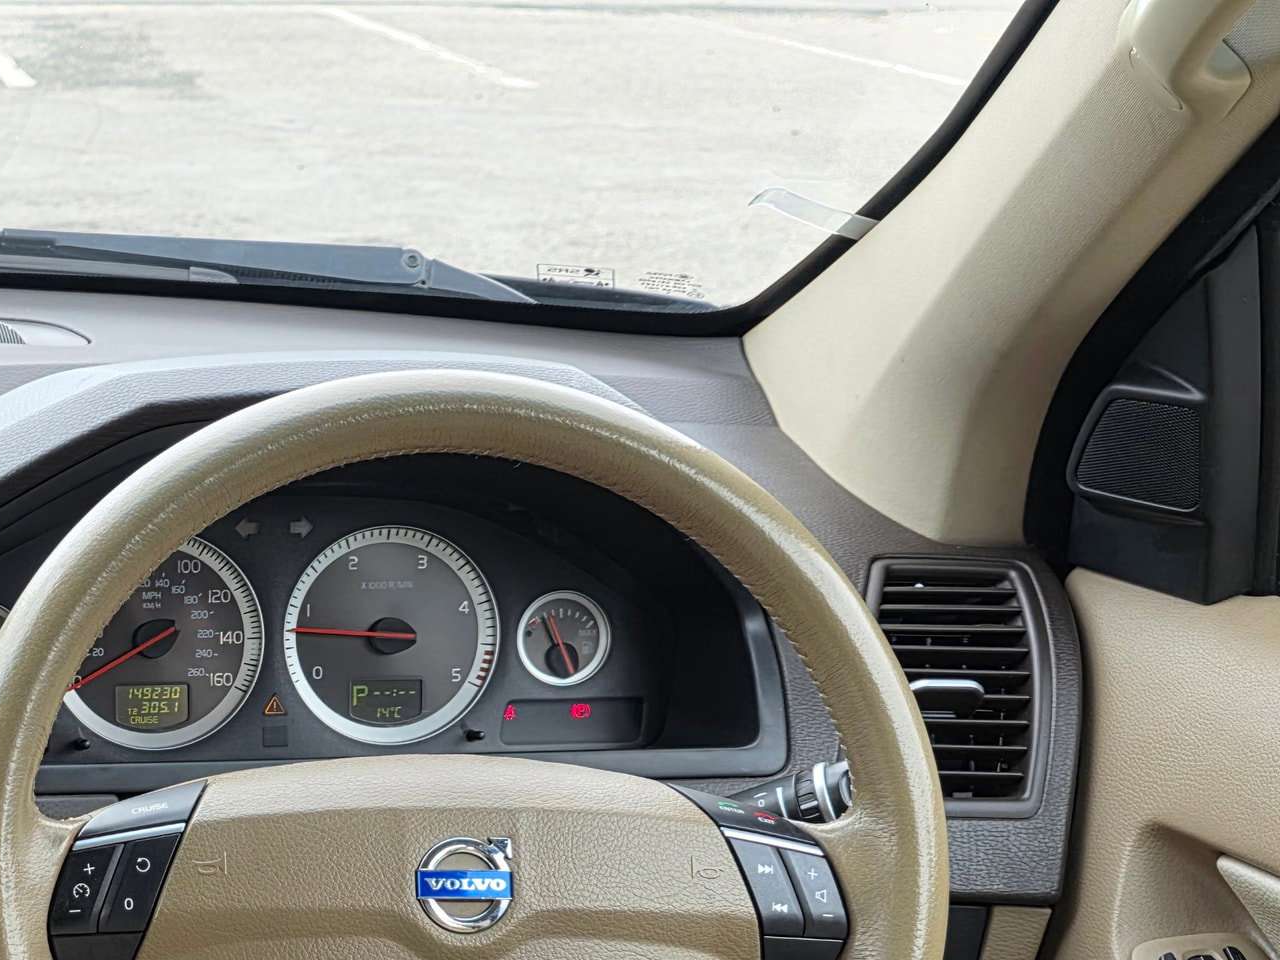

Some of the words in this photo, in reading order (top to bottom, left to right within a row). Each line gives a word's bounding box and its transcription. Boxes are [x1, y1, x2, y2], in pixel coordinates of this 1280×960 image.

[177, 560, 201, 574] 100
[348, 556, 358, 570] 2
[418, 555, 428, 569] 3
[142, 591, 161, 600] MPH
[184, 595, 198, 605] 180
[208, 589, 231, 603] 120
[306, 603, 311, 617] 1
[458, 600, 470, 614] 4
[191, 610, 209, 619] 200
[197, 629, 214, 638] 220
[220, 631, 243, 645] 140
[92, 647, 104, 657] 20
[195, 649, 213, 658] 240
[188, 668, 205, 677] 260
[210, 672, 233, 686] 160
[312, 666, 323, 680] 0
[452, 668, 461, 682] 5
[128, 687, 180, 699] 149230
[353, 685, 368, 706] P
[130, 715, 159, 724] CRUISE
[424, 877, 506, 891] VOLVO
[124, 897, 134, 910] 0
